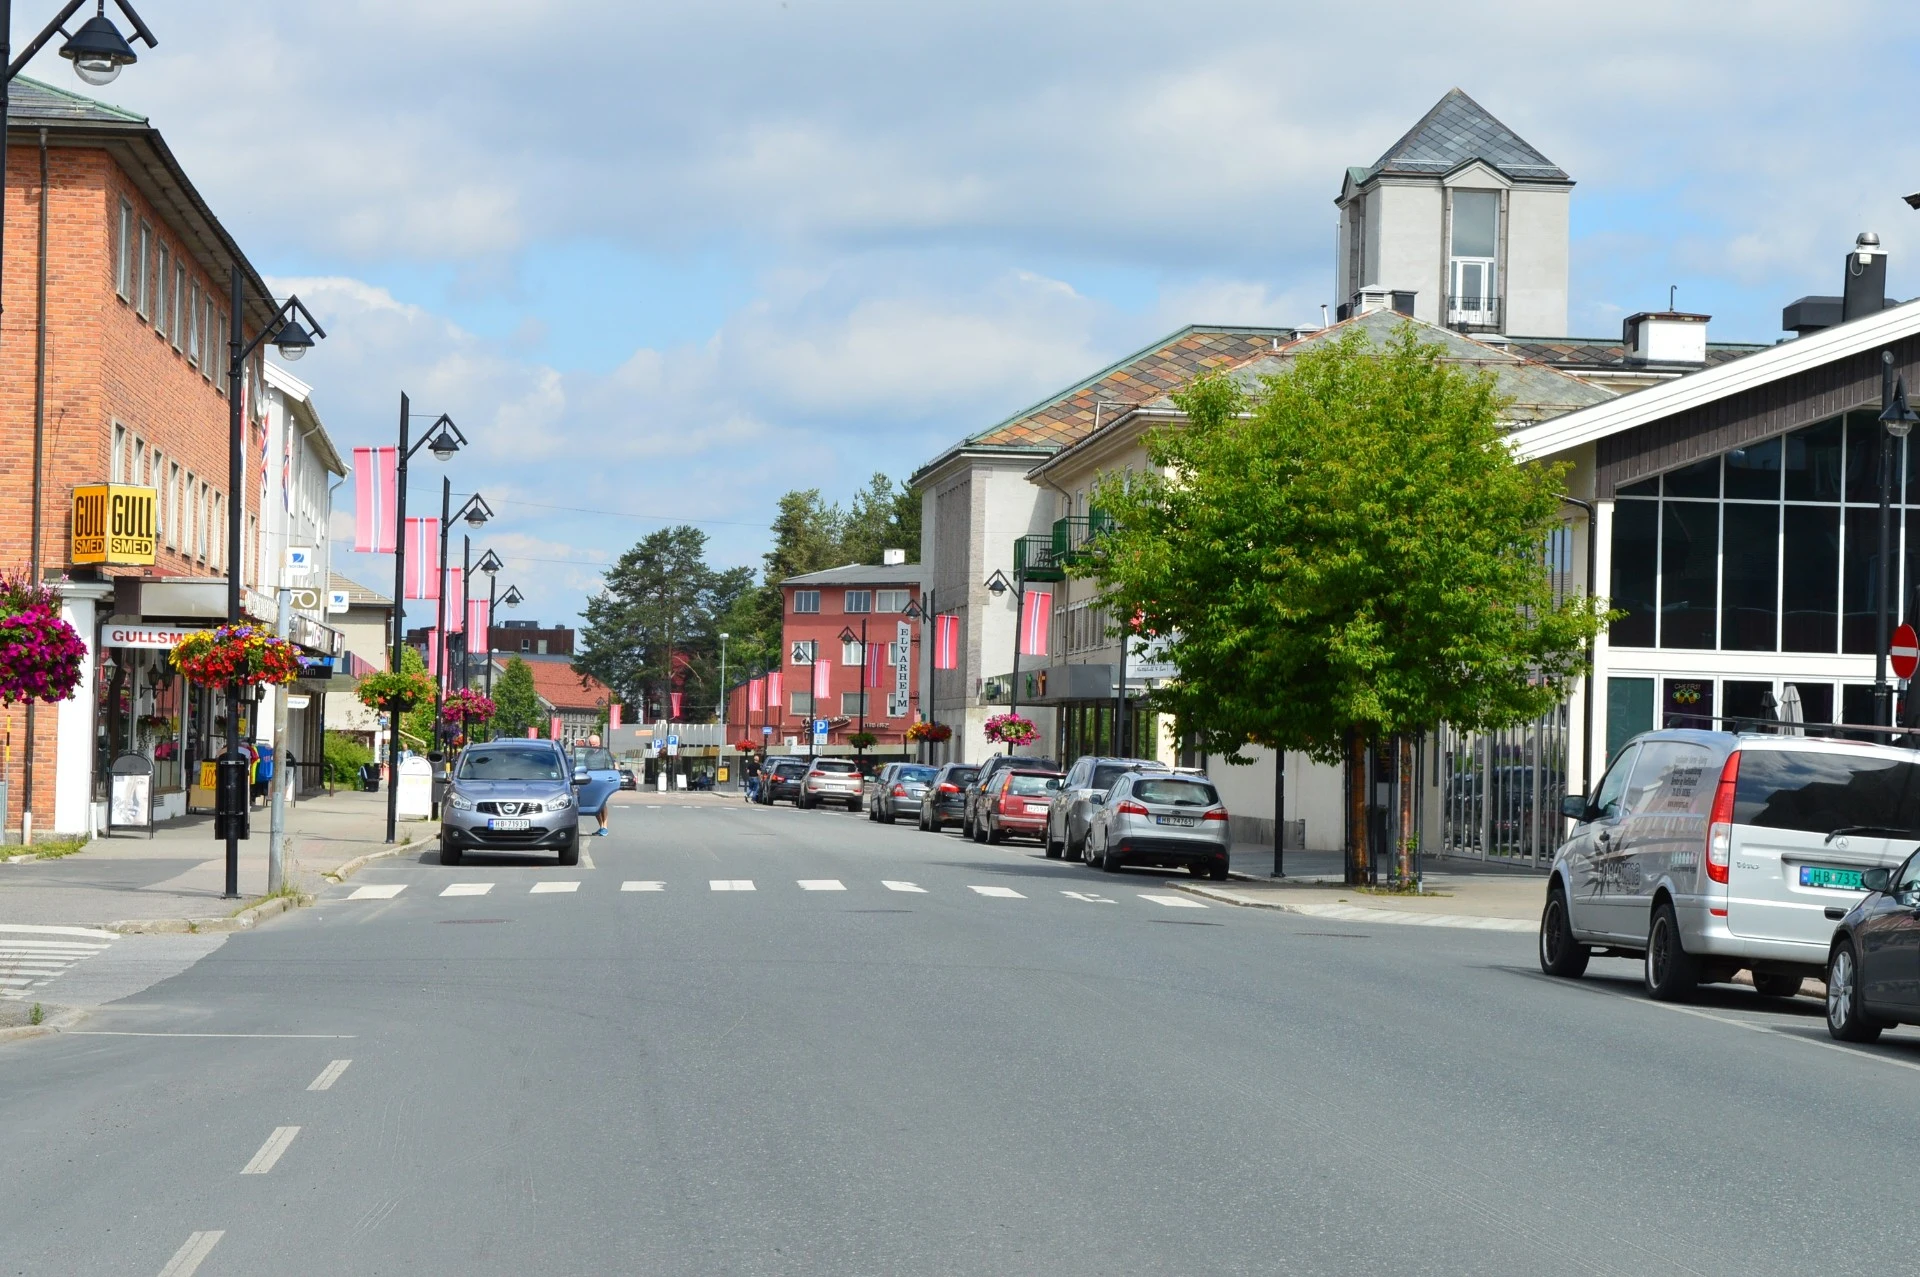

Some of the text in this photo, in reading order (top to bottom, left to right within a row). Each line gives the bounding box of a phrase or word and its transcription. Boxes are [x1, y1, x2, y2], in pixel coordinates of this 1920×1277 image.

[75, 495, 104, 537] GULL
[112, 495, 152, 538] GULL
[75, 538, 104, 554] SMED
[112, 538, 152, 555] SMED
[897, 629, 909, 707] ELVARHEIM
[1813, 870, 1830, 883] HB
